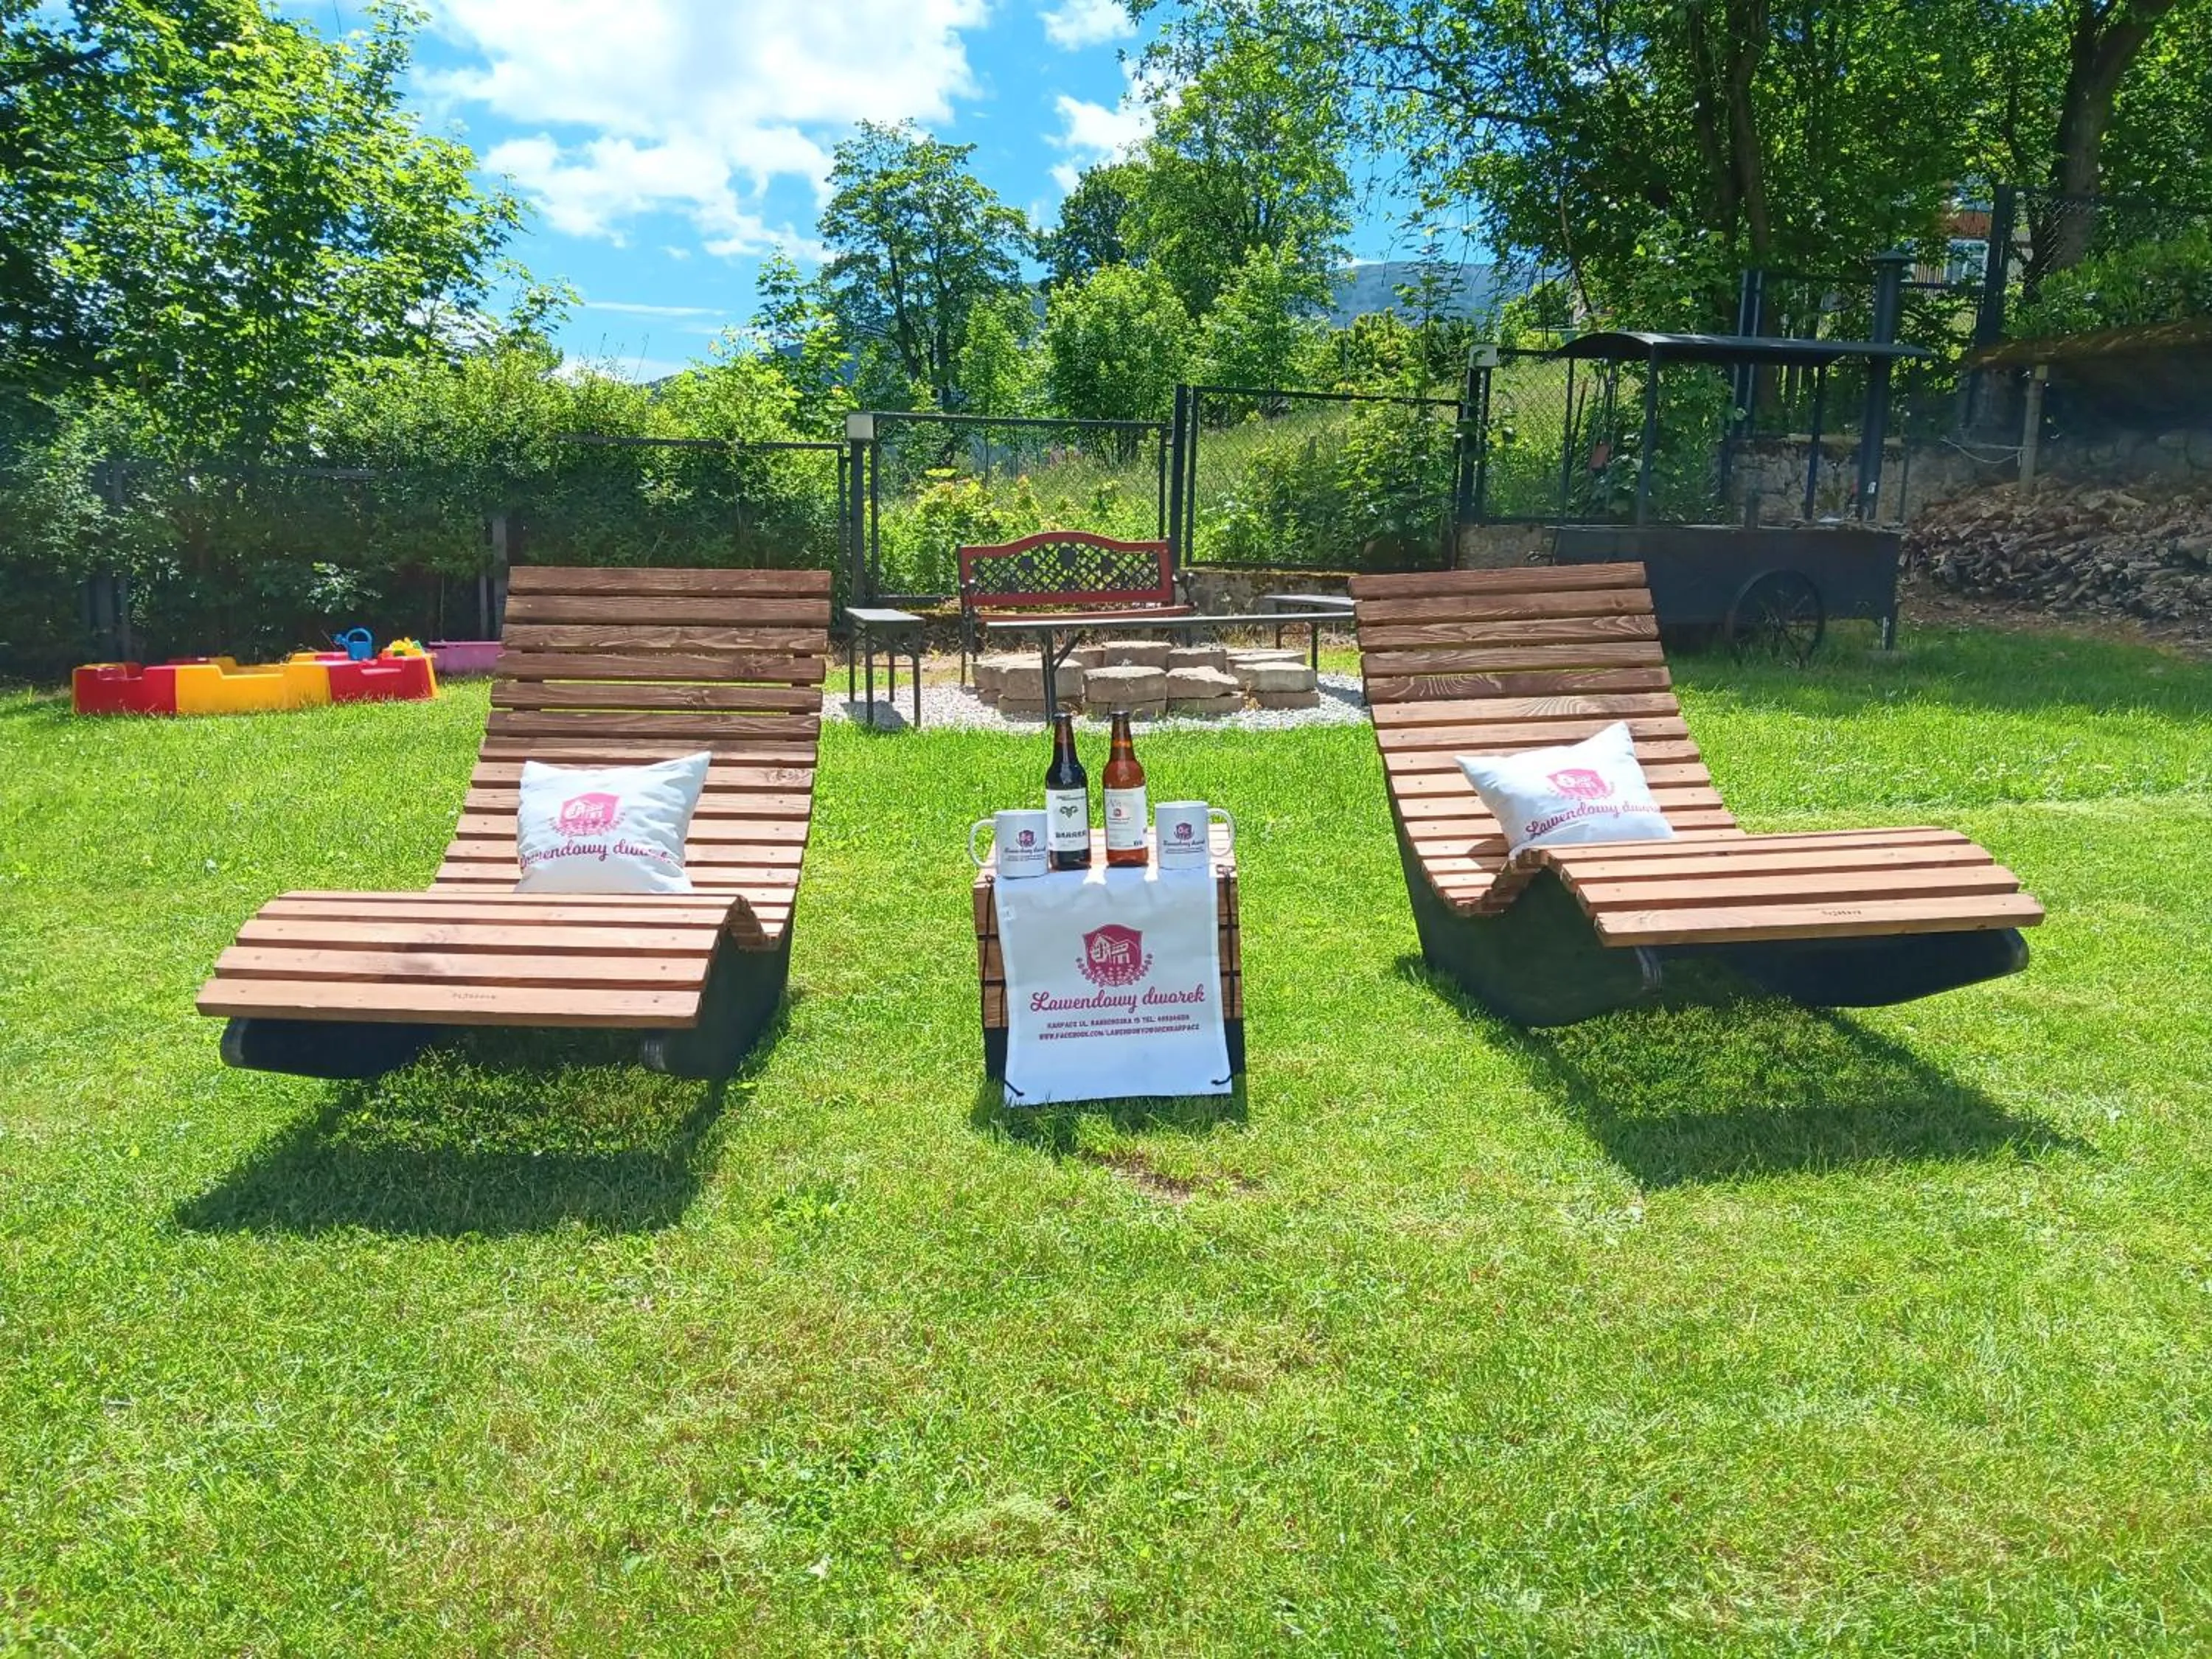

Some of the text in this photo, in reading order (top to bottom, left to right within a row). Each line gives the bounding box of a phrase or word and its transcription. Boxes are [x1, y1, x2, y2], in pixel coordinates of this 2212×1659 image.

[519, 840, 609, 869] endowy
[1030, 984, 1206, 1013] Lawendowy dworek
